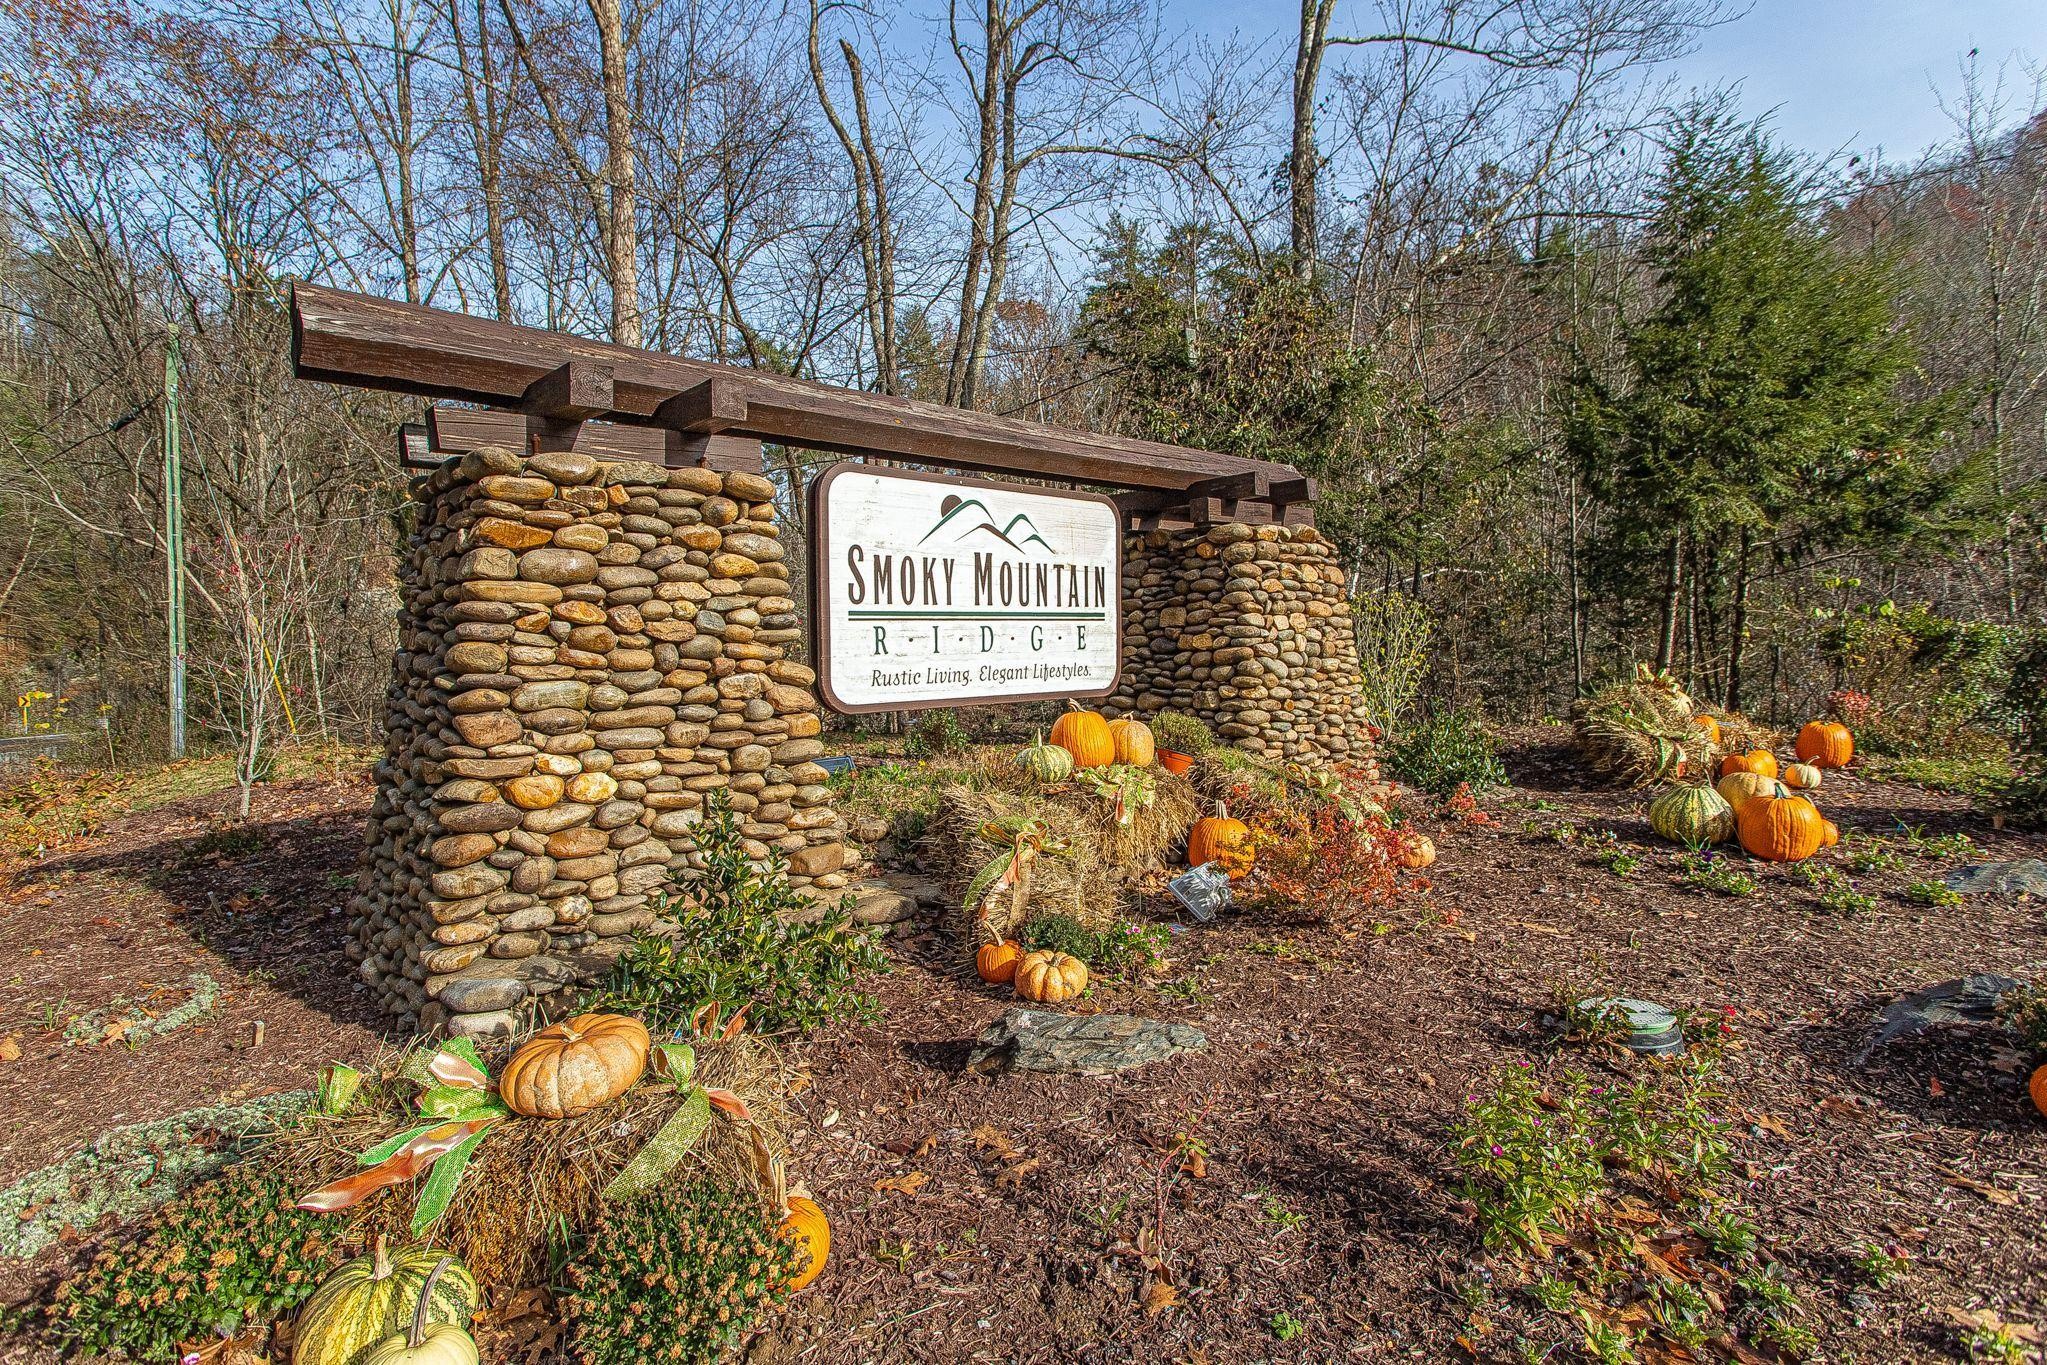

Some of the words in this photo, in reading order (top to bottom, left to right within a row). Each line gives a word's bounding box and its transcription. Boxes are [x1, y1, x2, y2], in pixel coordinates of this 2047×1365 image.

[848, 544, 955, 606] SMOKY
[973, 552, 1106, 608] MOUNTAIN
[871, 669, 922, 687] Rustic
[926, 667, 973, 687] Living.
[979, 665, 1029, 684] Elegant
[1033, 663, 1092, 682] Lifestyles.
